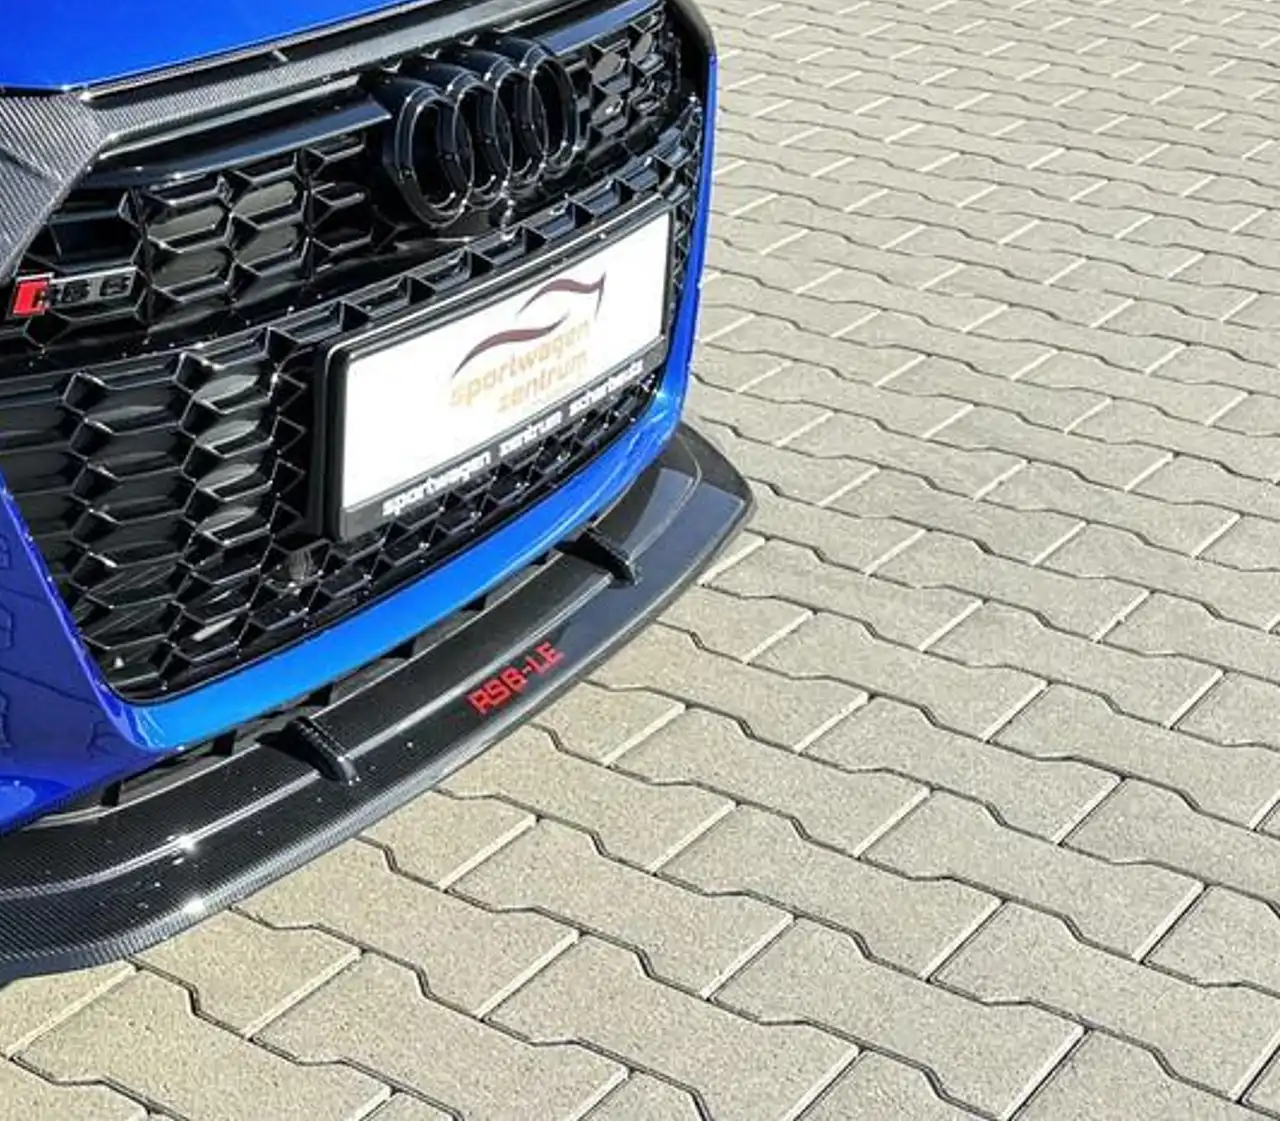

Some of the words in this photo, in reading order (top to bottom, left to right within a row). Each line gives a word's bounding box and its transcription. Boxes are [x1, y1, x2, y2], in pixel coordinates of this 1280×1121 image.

[448, 318, 590, 407] sportwagen
[498, 348, 588, 413] zentrum
[382, 451, 491, 516] sportwagen
[499, 409, 563, 457] zentrum
[466, 641, 566, 715] RS6-LE
